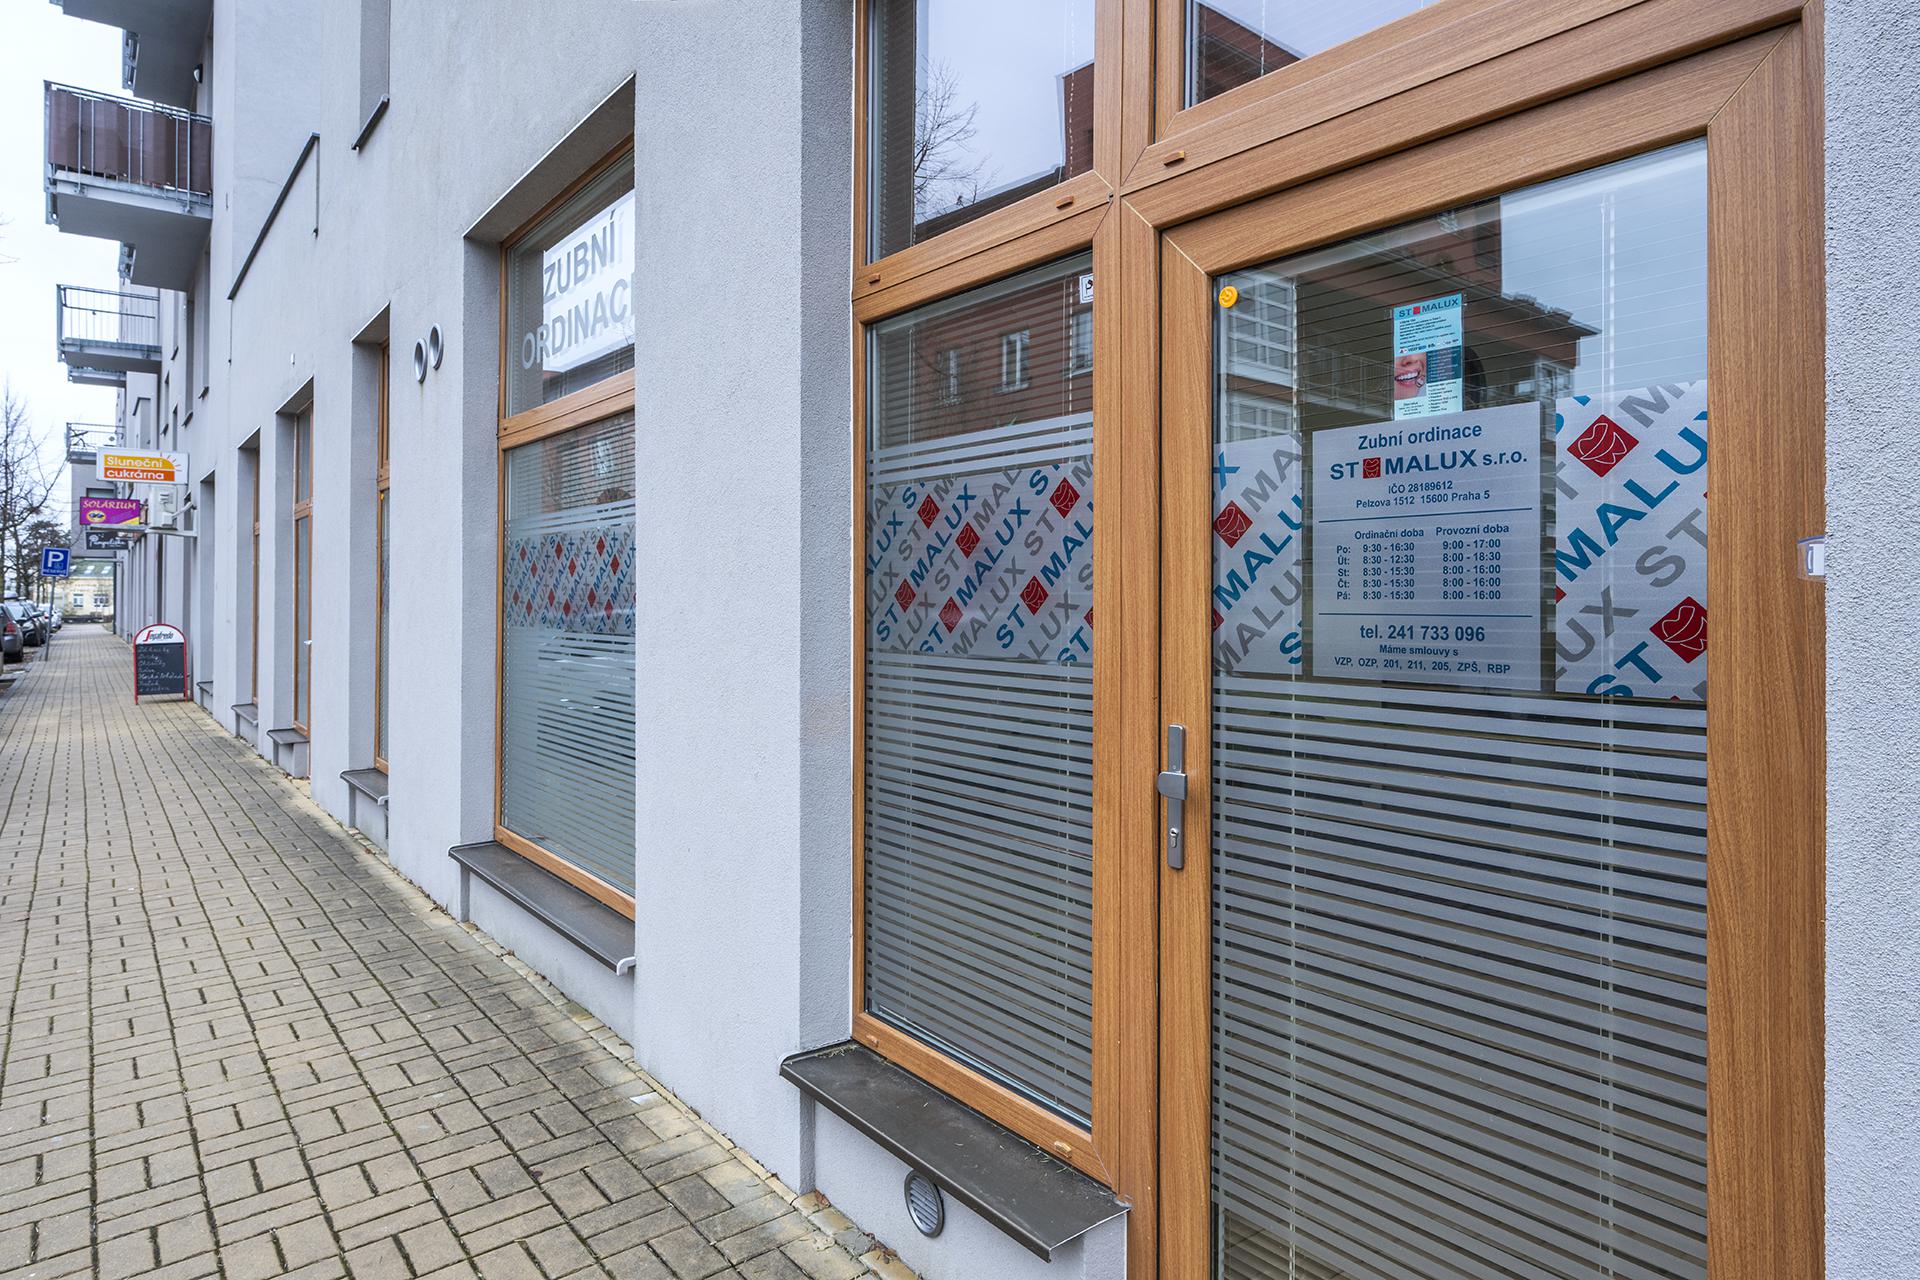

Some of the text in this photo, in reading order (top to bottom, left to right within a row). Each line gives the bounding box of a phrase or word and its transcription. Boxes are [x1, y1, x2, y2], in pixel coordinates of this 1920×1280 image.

[544, 208, 616, 301] ZUBNÍ
[522, 273, 635, 370] ORDINAC
[1358, 425, 1482, 450] Zubní ordinace
[107, 457, 163, 467] Sluneční
[1482, 451, 1528, 466] s.r.o.
[106, 469, 164, 480] cukrárna
[1388, 480, 1453, 494] IČO 28189612
[83, 500, 137, 510] SOLÁRIUM
[1356, 490, 1490, 509] Pelzova 1512 15600 Praha 5
[1354, 523, 1510, 540] Ordinační doba Provozní doba
[1336, 545, 1351, 554] Po:
[1362, 543, 1382, 553] 9:30
[1390, 542, 1415, 552] 16:30
[1442, 540, 1464, 550] 9:00
[1473, 538, 1501, 549] 17:00
[48, 551, 64, 567] P
[1337, 555, 1350, 565] Út:
[1362, 556, 1382, 564] 8:30
[1390, 555, 1415, 564] 12:30
[1442, 553, 1464, 562] 8:00
[1473, 551, 1501, 561] 18:30
[1337, 568, 1350, 577] St:
[1362, 568, 1382, 577] 8:30
[1390, 567, 1415, 576] 15:30
[1442, 566, 1464, 575] 8:00
[1473, 564, 1501, 574] 16:00
[1337, 578, 1350, 588] Čt:
[1362, 579, 1382, 588] 8:30
[1390, 579, 1415, 588] 15:30
[1442, 578, 1464, 587] 8:00
[1473, 578, 1501, 587] 16:00
[1336, 590, 1351, 600] Pá:
[1362, 591, 1382, 600] 8:30
[1390, 591, 1415, 600] 15:30
[1442, 591, 1464, 600] 8:00
[1473, 590, 1501, 600] 16:00
[1360, 625, 1485, 641] tel. 241 733 096
[1379, 644, 1407, 654] Máme
[1409, 646, 1450, 657] smlouvy
[1487, 663, 1511, 674] RBP
